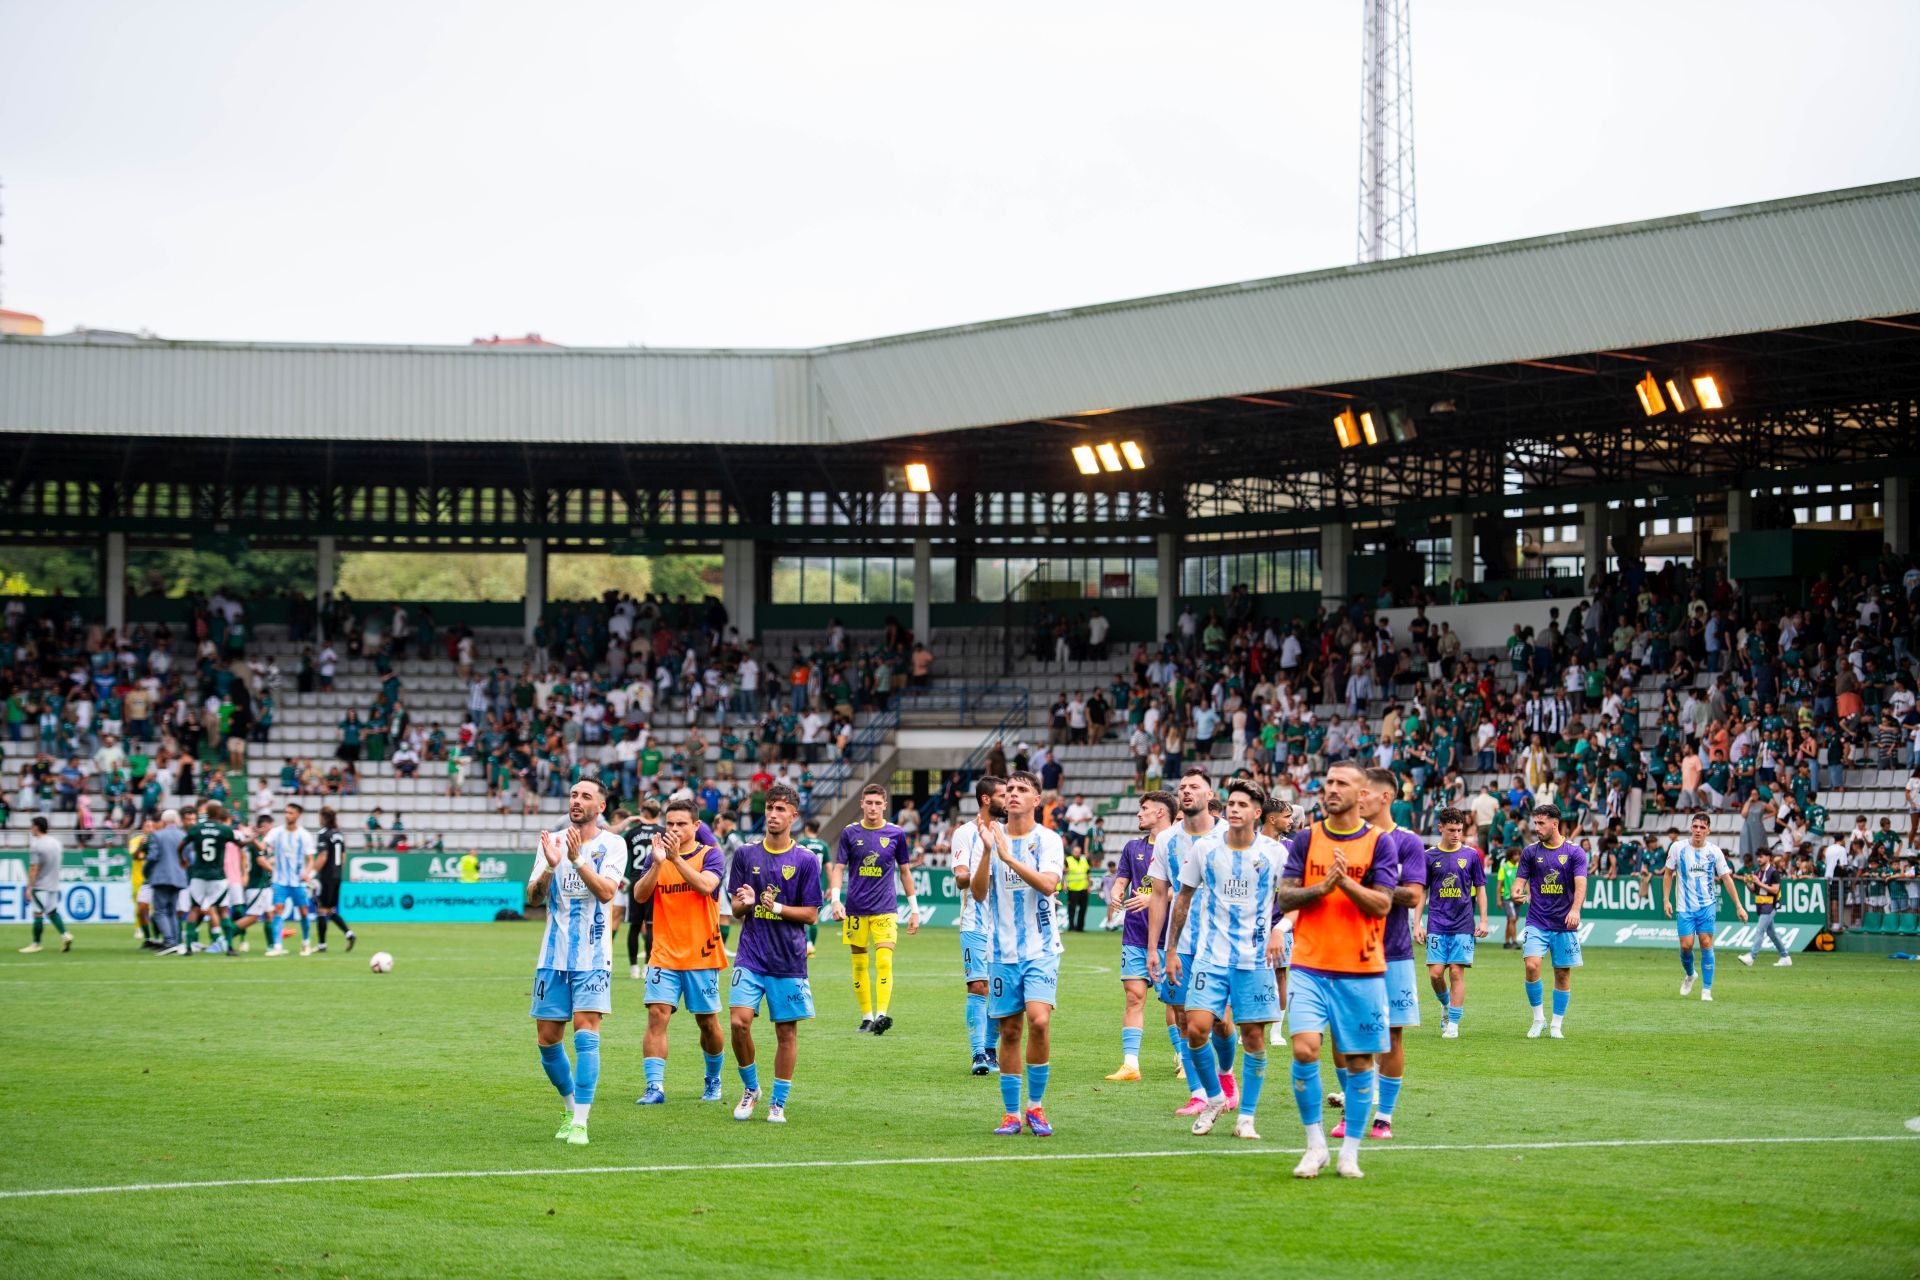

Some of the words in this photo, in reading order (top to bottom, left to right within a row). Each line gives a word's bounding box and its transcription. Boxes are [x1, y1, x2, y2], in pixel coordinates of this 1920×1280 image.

[202, 838, 217, 862] 5
[445, 856, 508, 875] Cuña
[1744, 882, 1826, 913] LIGA
[847, 915, 860, 930] 13
[993, 977, 1003, 998] 9
[1253, 995, 1276, 1003] MGS
[1391, 999, 1414, 1008] MGS
[1359, 1022, 1385, 1033] MGS
